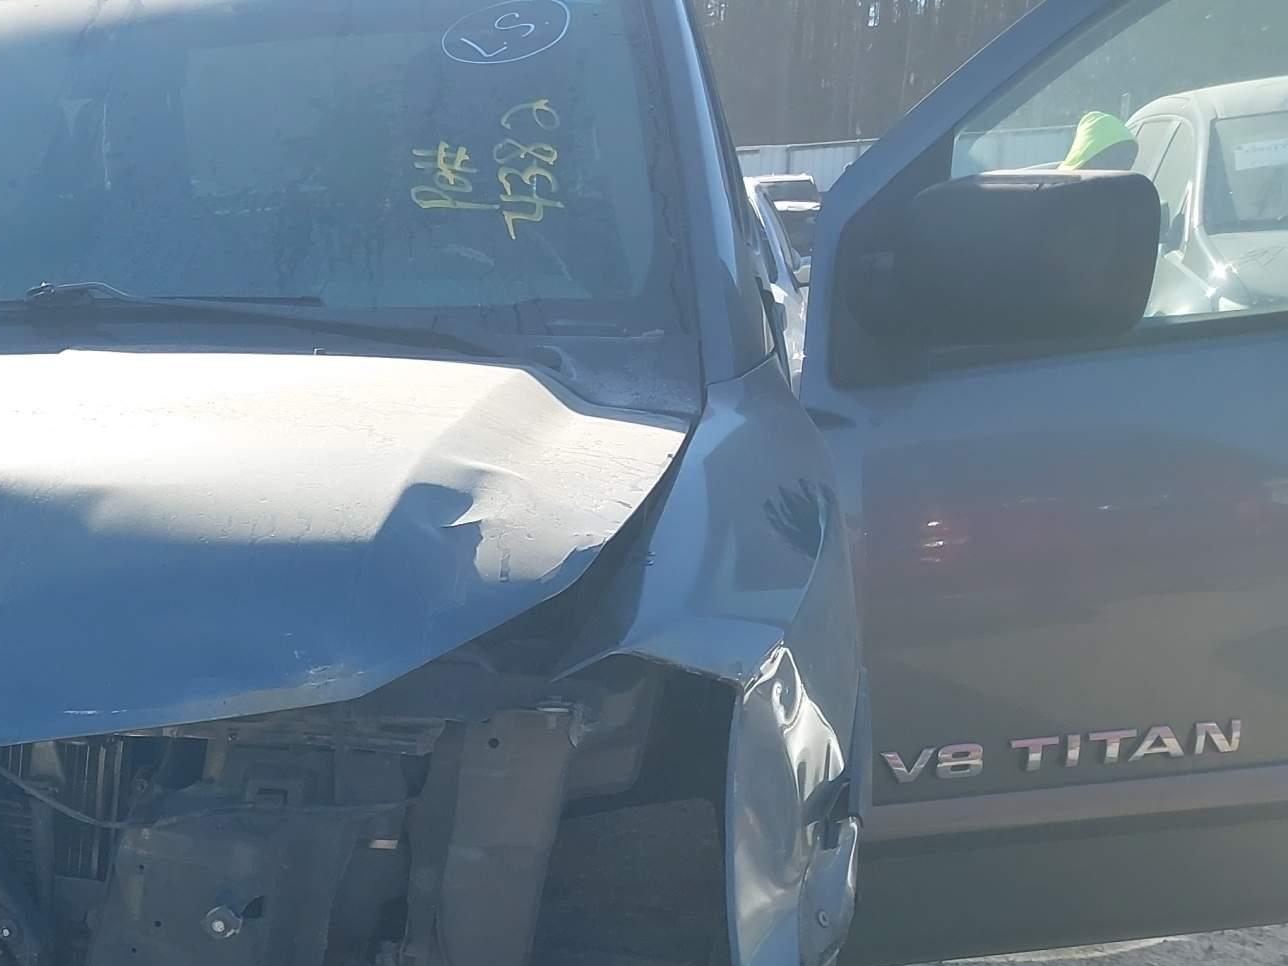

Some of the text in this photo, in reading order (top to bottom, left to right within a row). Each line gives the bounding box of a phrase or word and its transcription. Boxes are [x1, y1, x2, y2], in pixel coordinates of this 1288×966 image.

[492, 98, 565, 240] 4382
[880, 719, 1242, 784] V8 TITAN
